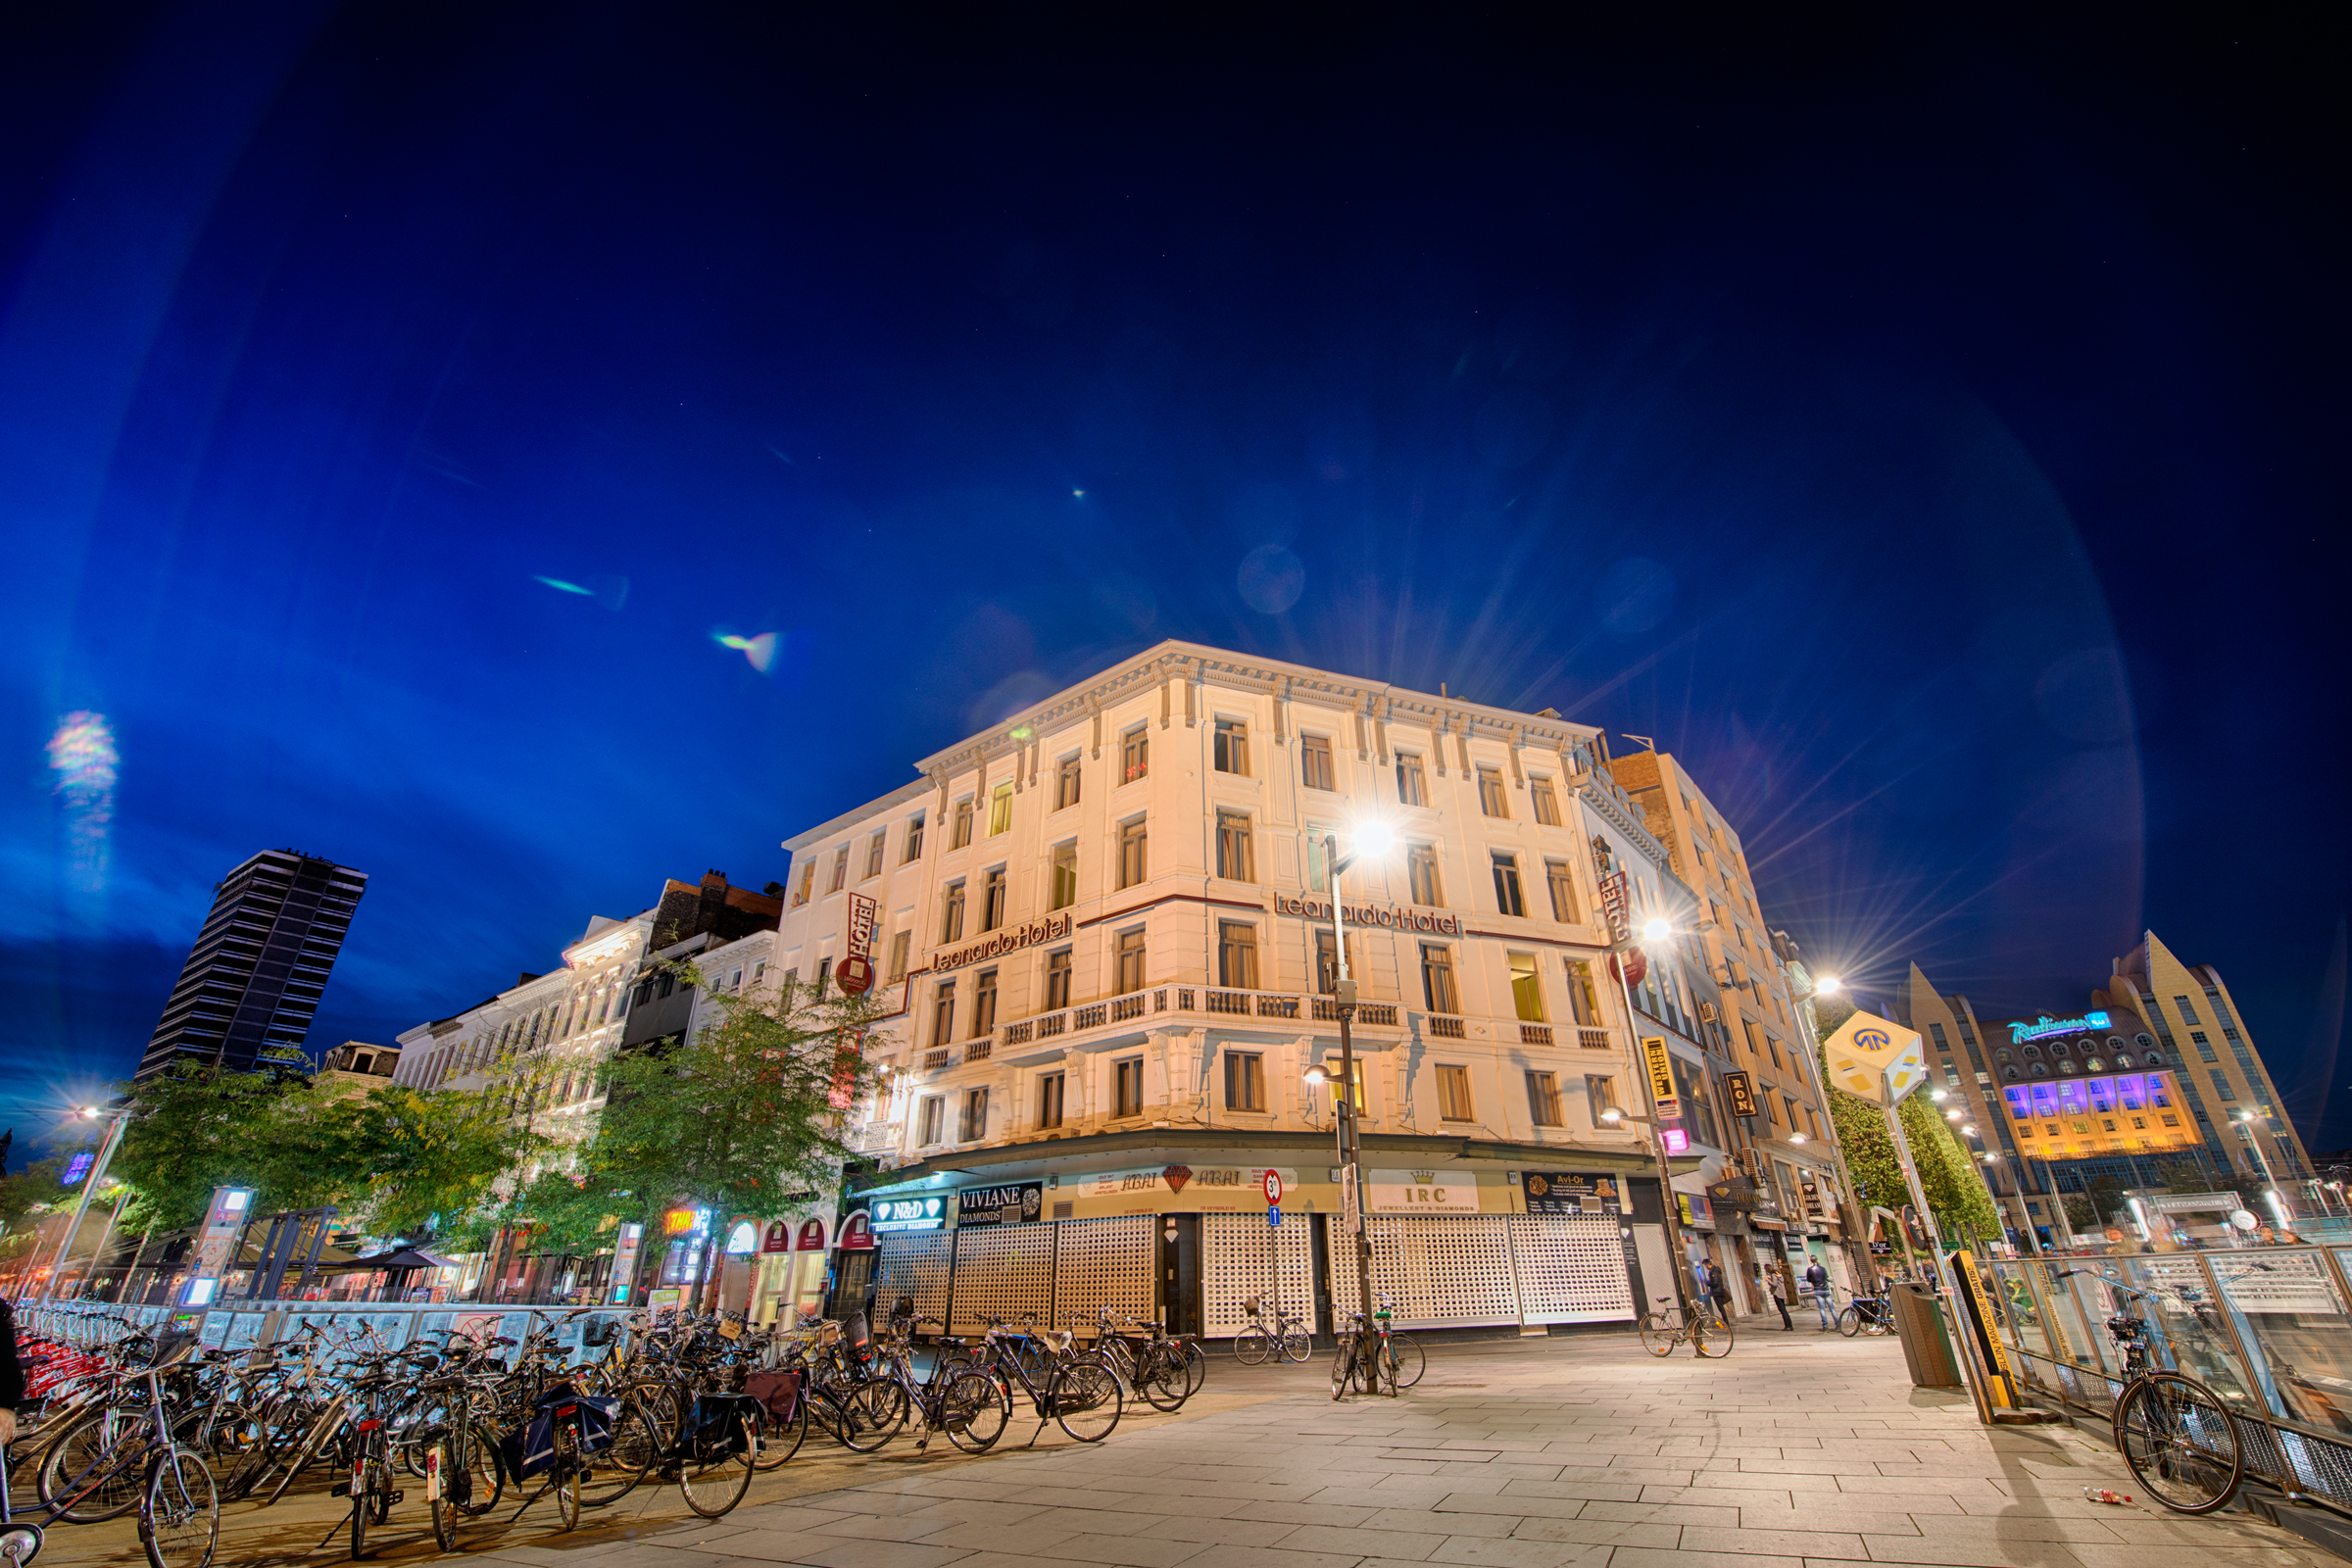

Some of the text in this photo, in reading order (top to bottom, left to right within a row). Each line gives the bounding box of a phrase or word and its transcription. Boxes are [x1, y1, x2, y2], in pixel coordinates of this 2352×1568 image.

[1274, 891, 1459, 936] Leonardo Hotel
[850, 897, 874, 957] HOTEL
[933, 912, 1070, 973] Leonardo Hotel
[1649, 1050, 1666, 1096] WESTERN
[1655, 1049, 1669, 1081] UNION
[1732, 1079, 1748, 1110] RON
[1120, 1172, 1157, 1192] ABAI
[1197, 1169, 1241, 1187] ABAI
[1557, 1175, 1585, 1184] Avi-Or
[961, 1186, 1020, 1208] VIVIANE
[1405, 1188, 1446, 1202] IRC
[891, 1200, 923, 1220] N&D
[959, 1210, 1001, 1224] DIAMONDS
[907, 1221, 939, 1231] DIAMONDS
[1966, 1265, 1984, 1299] GRATIS!
[1980, 1300, 1999, 1344] MAGAZINE
